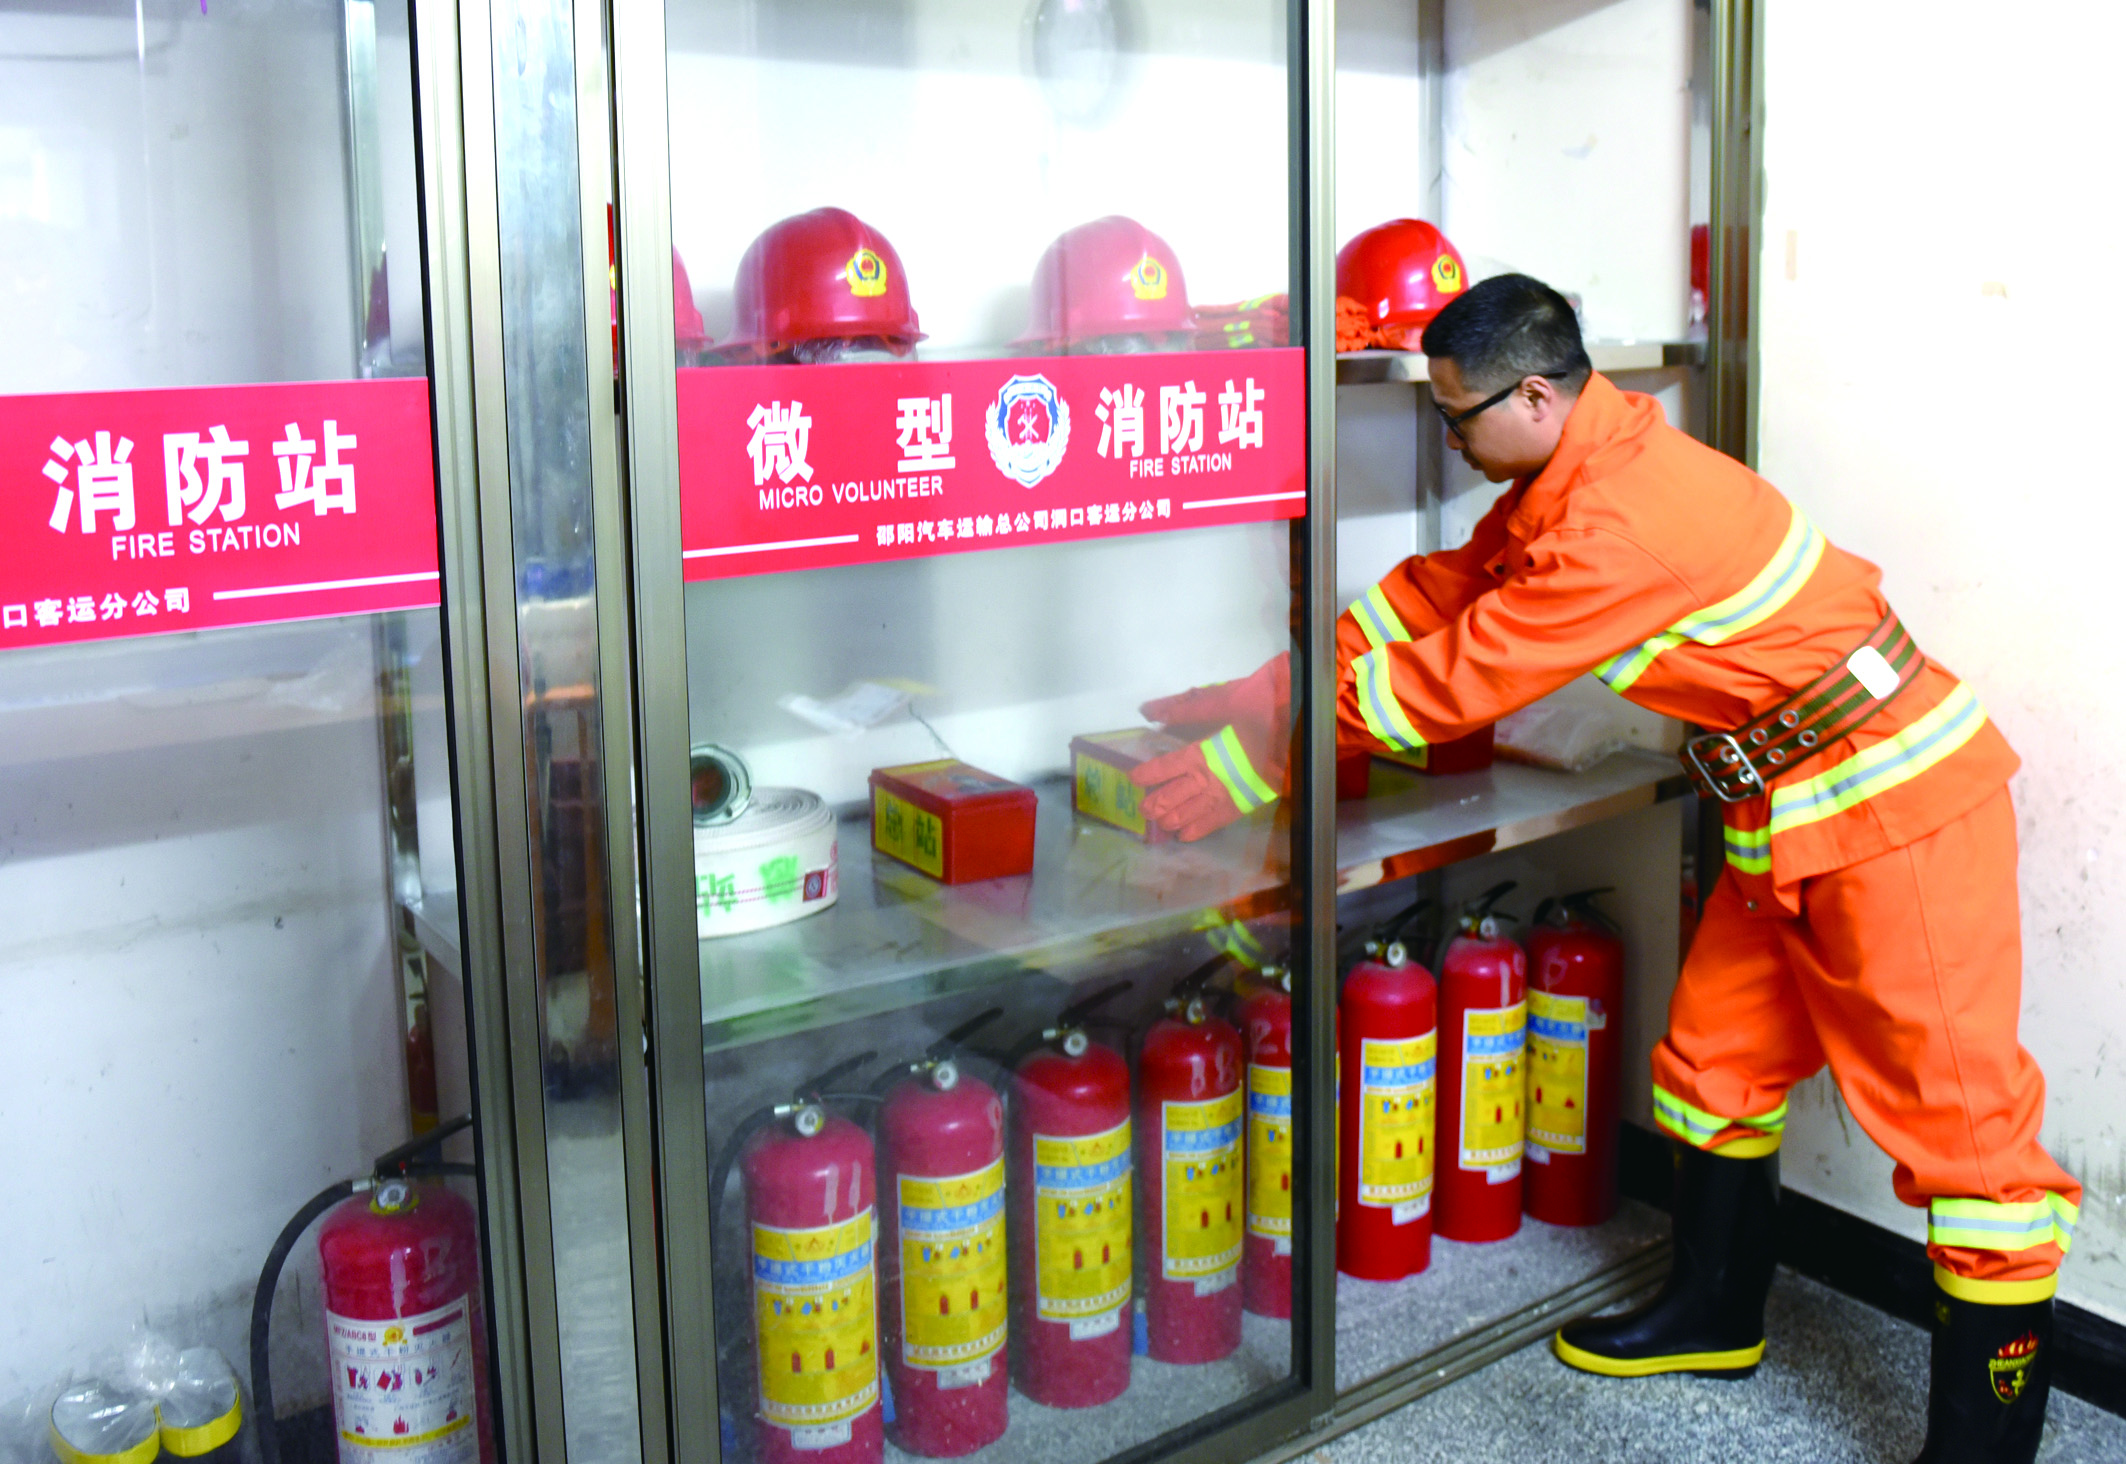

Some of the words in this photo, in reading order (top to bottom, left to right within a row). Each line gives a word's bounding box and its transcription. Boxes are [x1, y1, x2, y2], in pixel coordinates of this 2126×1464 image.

[746, 394, 956, 486] 微型
[1095, 378, 1265, 459] 消防站
[43, 420, 358, 534] 消防站
[1129, 457, 1164, 479] FIRE
[1171, 453, 1232, 476] STATION
[759, 485, 823, 510] MICRO
[832, 476, 943, 504] VOLUNTEER
[112, 532, 175, 561] FIRE
[189, 523, 300, 554] STATION
[876, 499, 1171, 546] 邵阳汽车运输总公司洞口客运分公司
[3, 588, 190, 629] 口客运分公司
